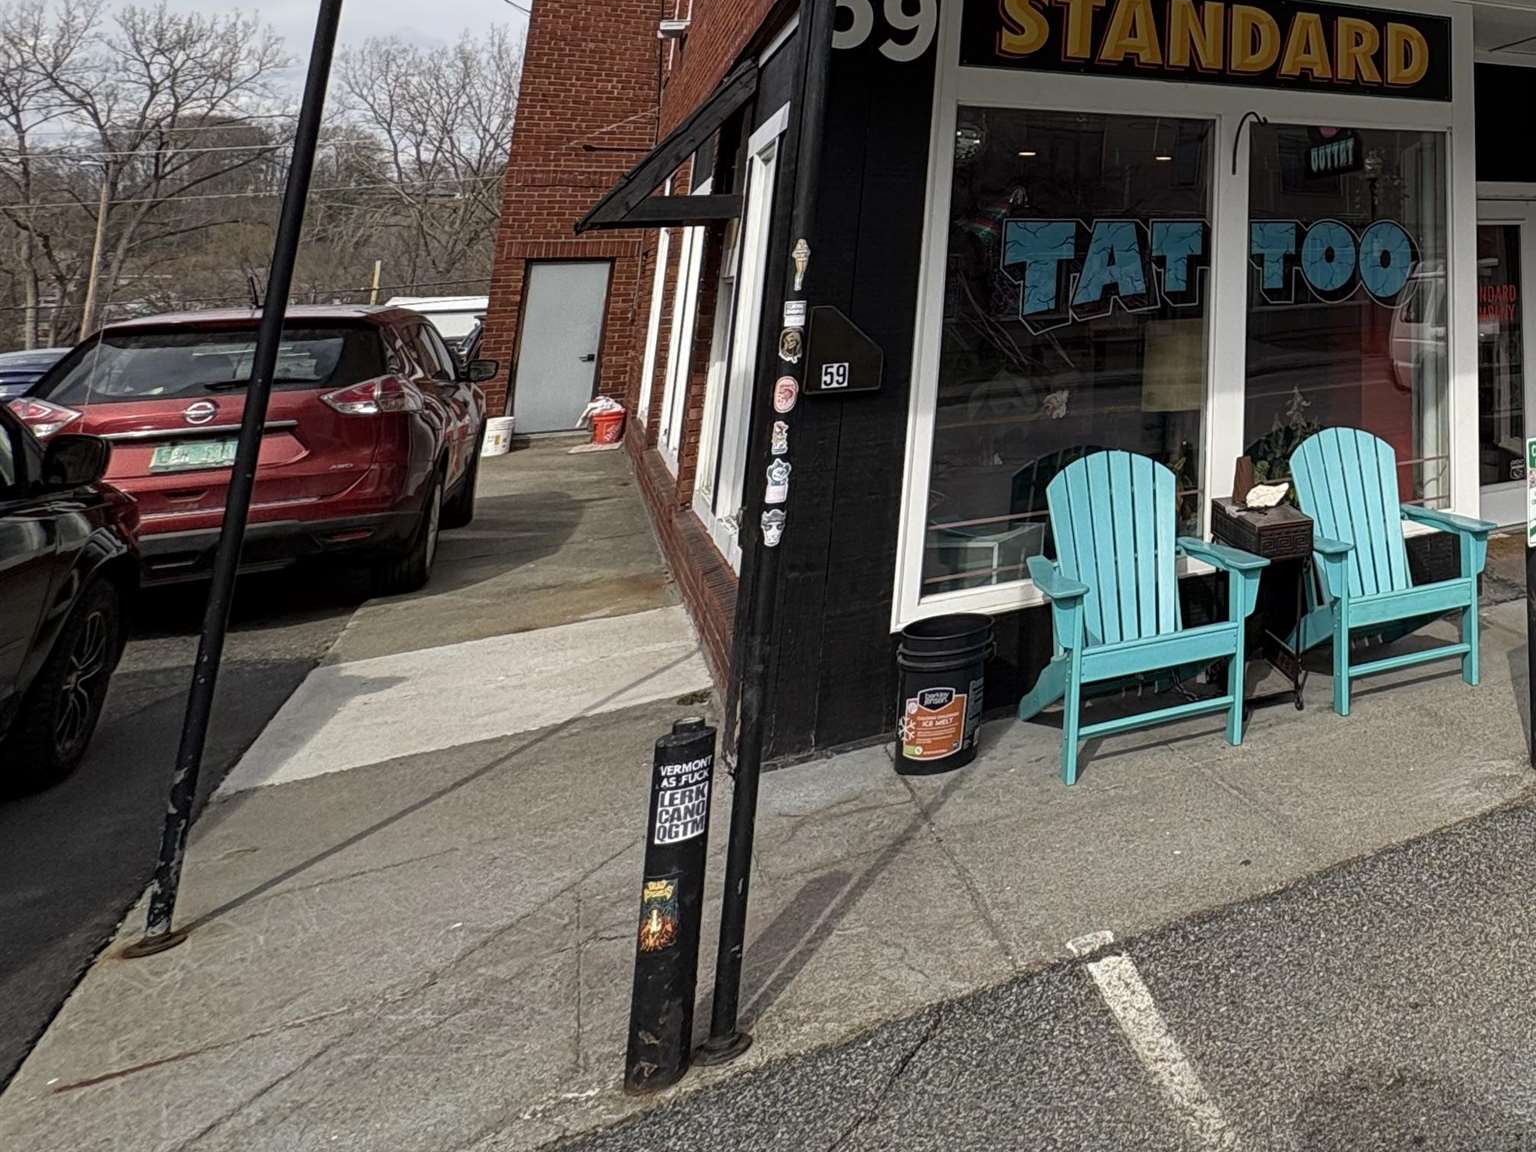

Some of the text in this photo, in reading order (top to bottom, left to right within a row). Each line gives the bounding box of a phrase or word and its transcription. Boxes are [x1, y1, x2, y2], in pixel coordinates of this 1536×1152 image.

[1479, 284, 1517, 303] NDARD
[823, 364, 848, 387] 59
[935, 717, 953, 726] MELT
[660, 755, 712, 776] VERMONT
[660, 768, 709, 788] AS FUCK
[659, 799, 706, 825] CANO
[656, 814, 705, 842] QGTM
